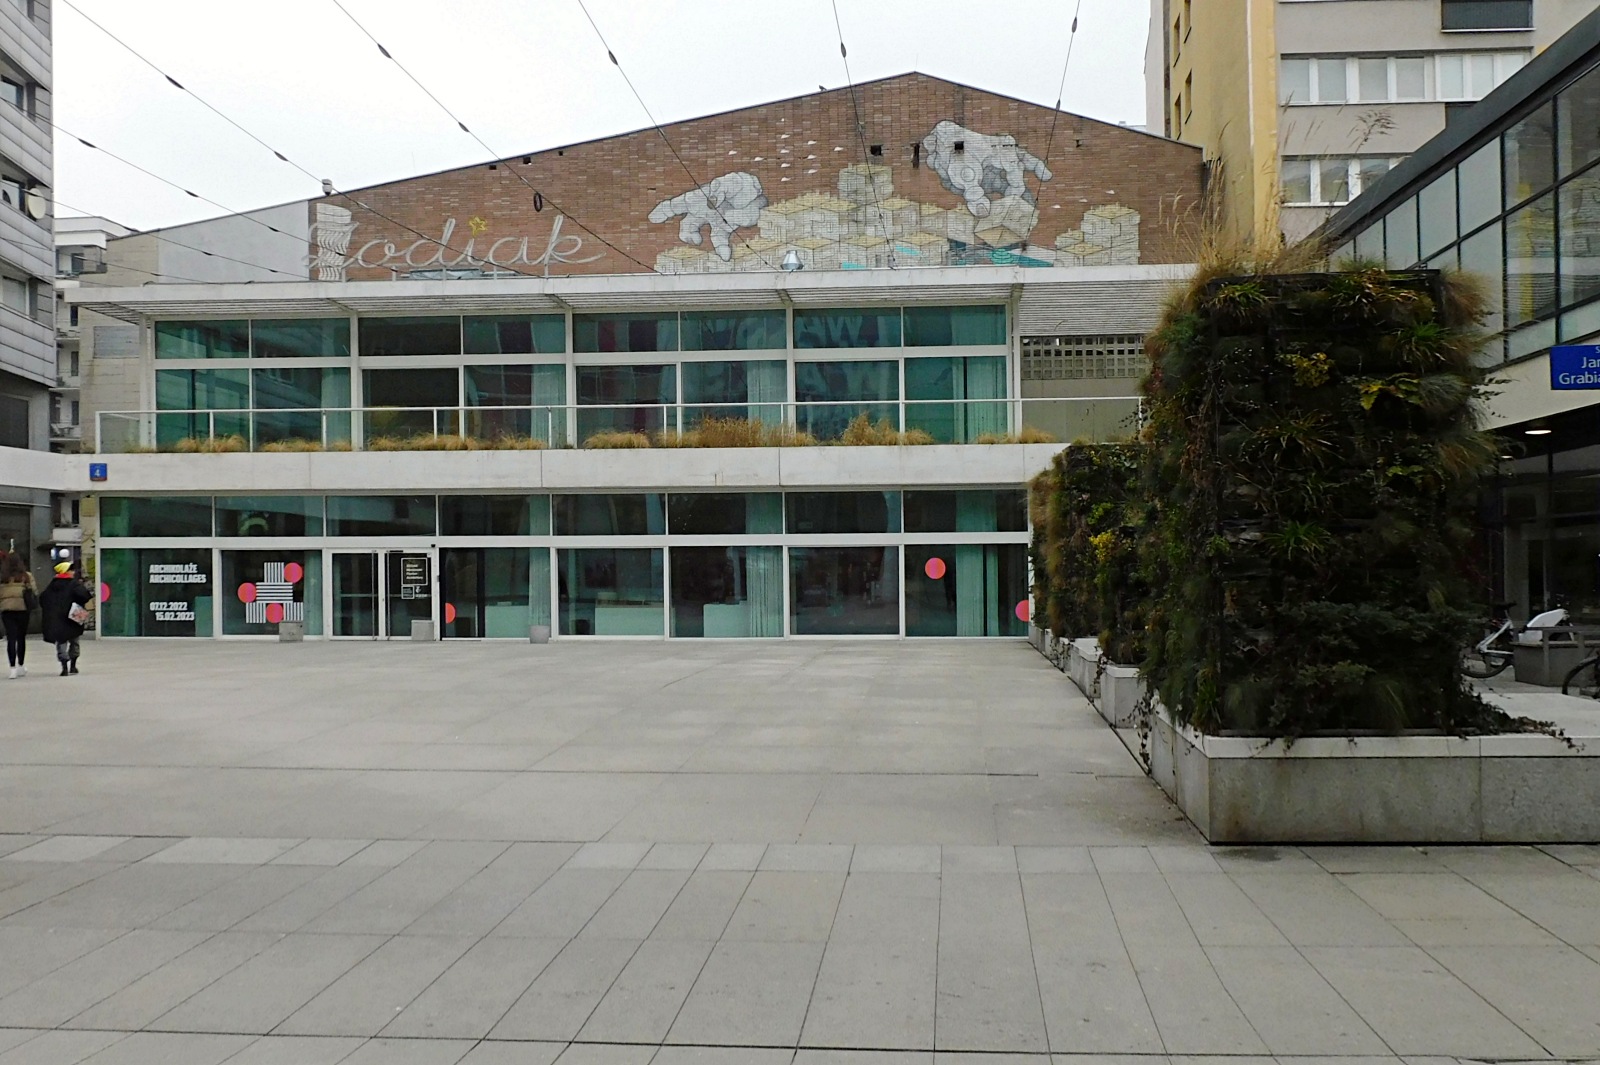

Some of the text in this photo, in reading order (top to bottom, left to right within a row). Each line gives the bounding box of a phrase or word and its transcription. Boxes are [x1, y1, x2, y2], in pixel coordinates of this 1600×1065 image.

[94, 469, 100, 477] 4
[149, 574, 206, 583] ARCHICOLLAGES
[155, 612, 195, 620] 15.02.2023
